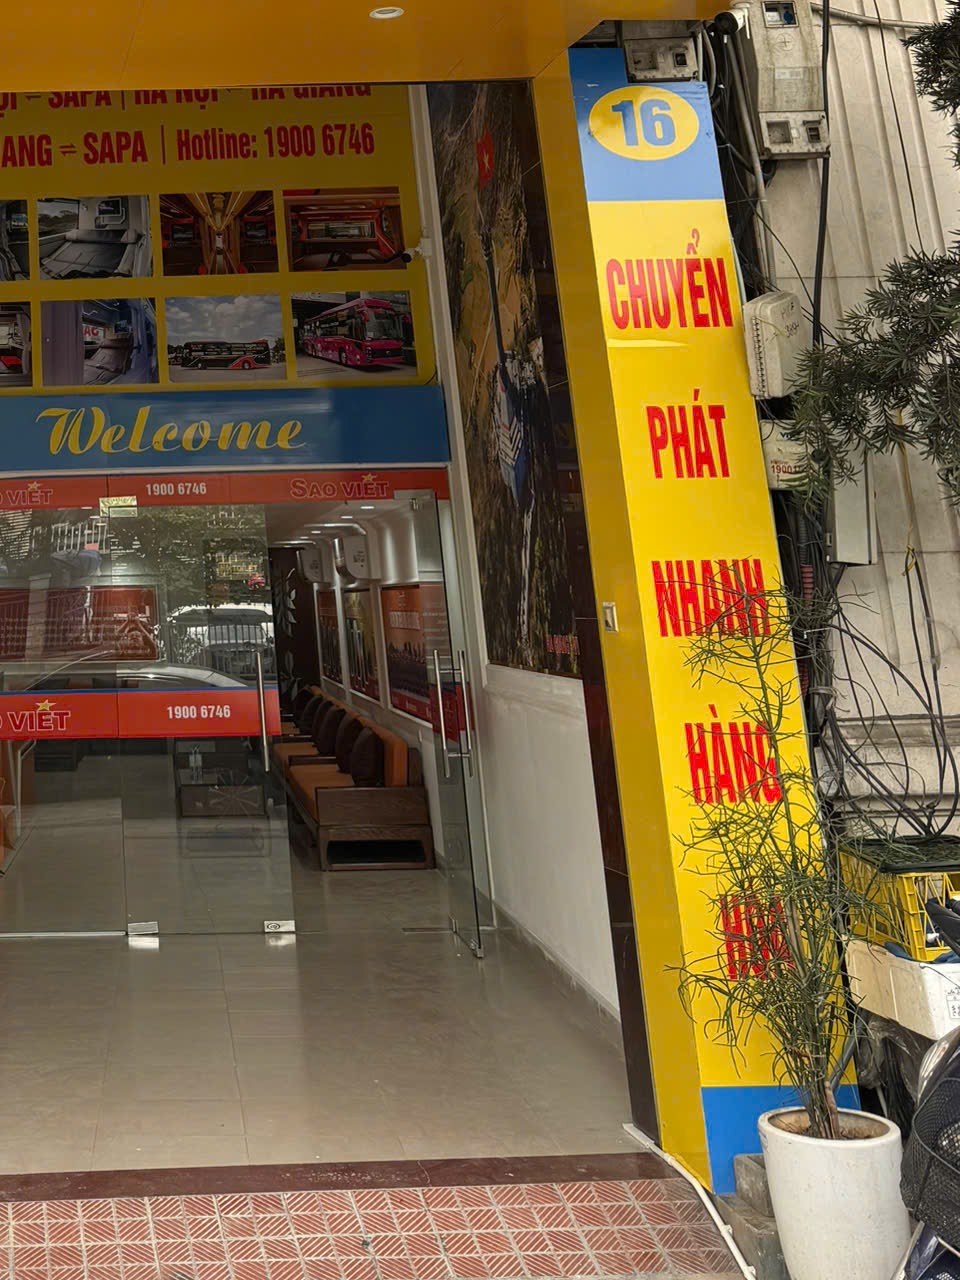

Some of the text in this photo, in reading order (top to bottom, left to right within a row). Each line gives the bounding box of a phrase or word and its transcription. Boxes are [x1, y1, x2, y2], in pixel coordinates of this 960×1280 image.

[83, 130, 148, 165] SAPA
[176, 128, 258, 161] Hotline:
[264, 125, 316, 158] 1900
[322, 122, 375, 156] 6746
[611, 98, 676, 147] 16
[606, 228, 734, 329] CHUYỂN
[36, 405, 307, 456] Welcome
[646, 389, 730, 479] PHÁT
[145, 483, 174, 496] 1900
[177, 482, 207, 495] 6746
[652, 559, 771, 637] NHANH
[167, 705, 197, 719] 1900
[200, 704, 231, 718] 6746
[685, 704, 784, 804] HÀNG
